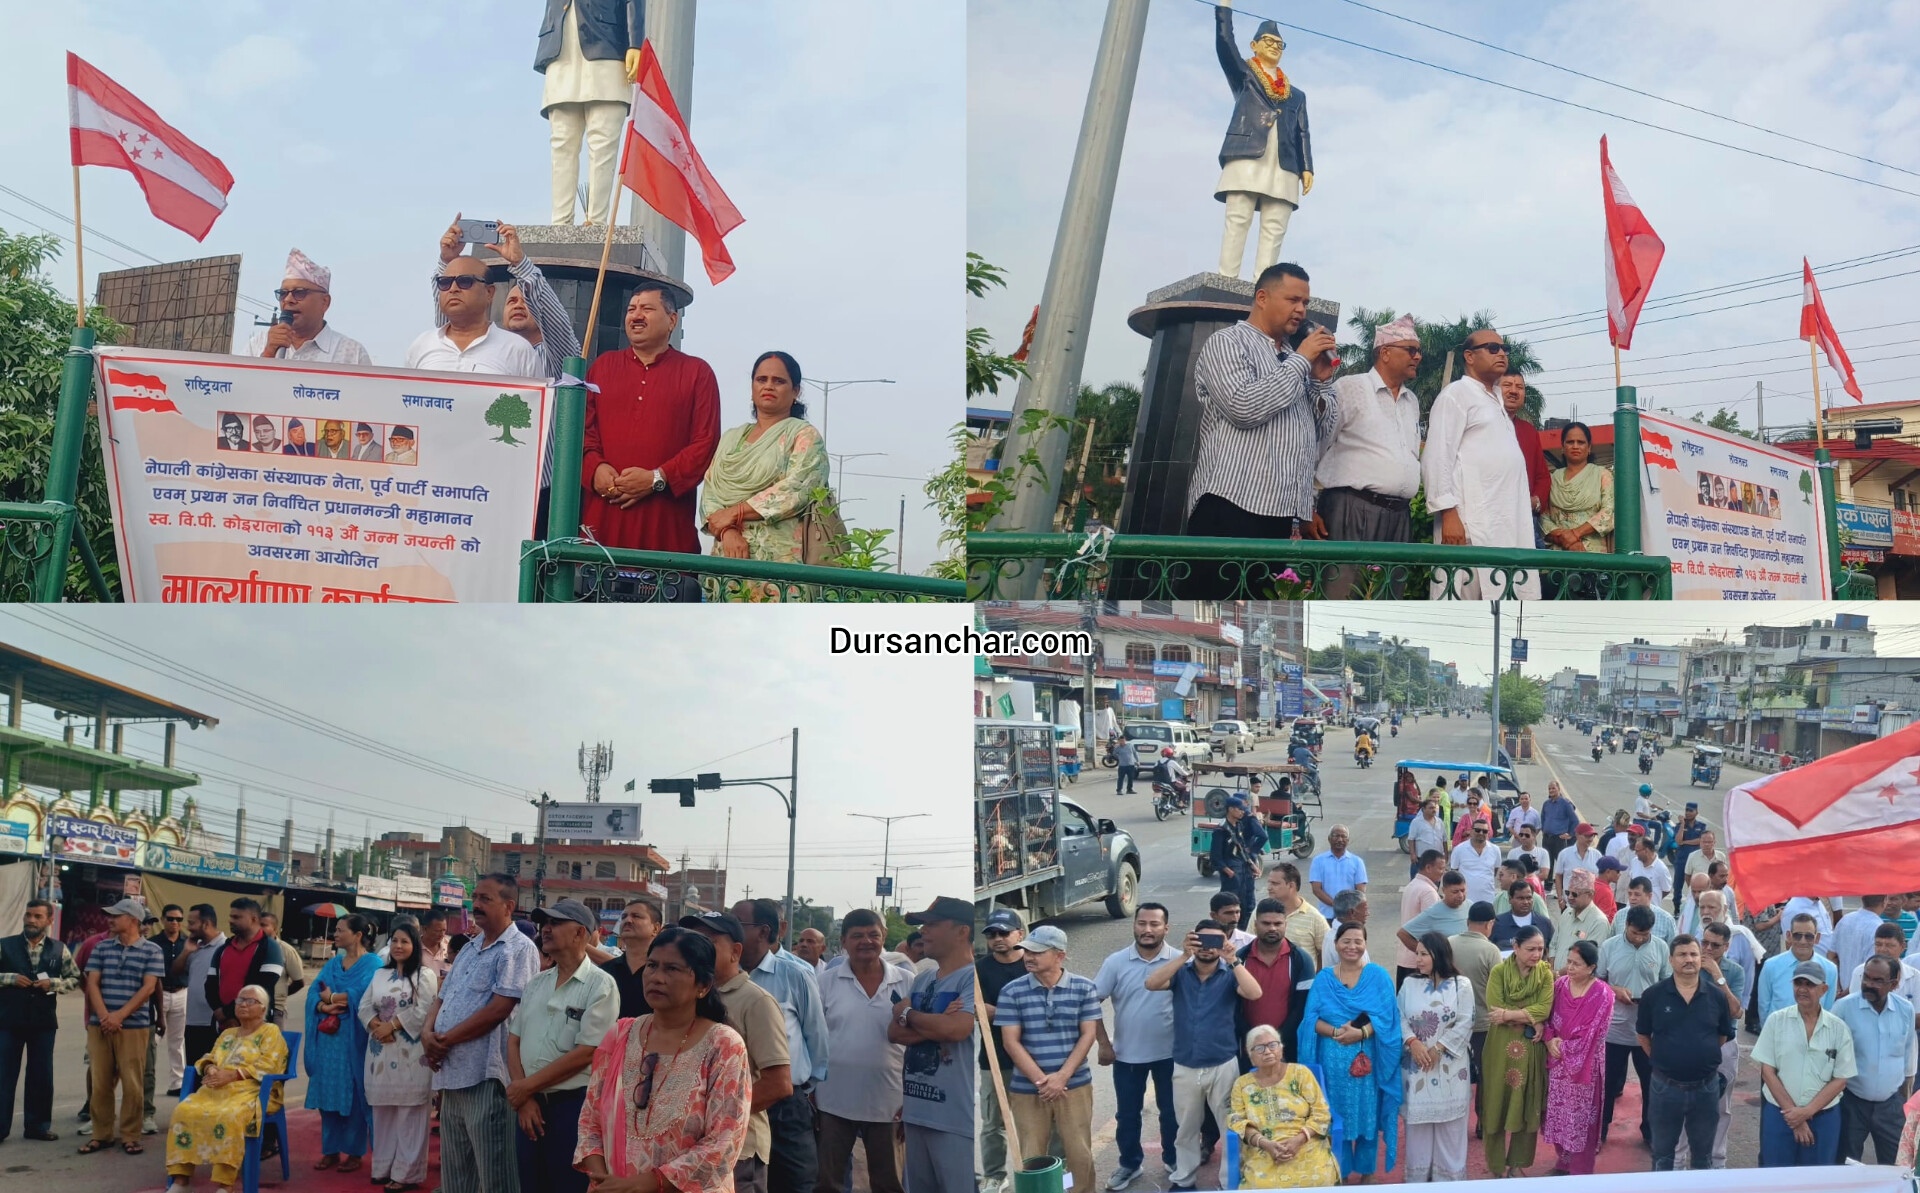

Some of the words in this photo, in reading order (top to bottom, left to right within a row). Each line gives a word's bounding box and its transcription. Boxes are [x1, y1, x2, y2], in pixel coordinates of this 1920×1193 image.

[184, 376, 233, 395] राष्ट्रियता
[293, 384, 341, 401] लोकतन्त्र
[402, 394, 455, 412] समाजवाद
[145, 458, 192, 476] नेपाली
[195, 462, 259, 480] कांग्रेसका
[263, 467, 328, 486] संस्थापक
[332, 472, 364, 492] नेता,
[370, 477, 394, 497] पूर्व
[396, 480, 429, 496] पार्टी
[432, 485, 490, 502] सभापति
[152, 487, 187, 506] एवम्
[190, 489, 228, 504] प्रथम
[233, 492, 258, 506] जन
[263, 491, 320, 512] निर्वाचित
[325, 500, 401, 519] प्रधानमन्त्री
[406, 508, 474, 527] महामानव
[1666, 510, 1690, 527] नेपाली
[149, 513, 172, 526] स्व.
[178, 511, 216, 528] वि.पी.
[222, 514, 302, 535] कोइरालाको
[306, 524, 334, 541] ११३
[363, 530, 399, 545] जन्म
[404, 533, 456, 550] जयन्ती
[460, 536, 481, 553] को
[248, 544, 311, 561] अवसरमा
[315, 550, 379, 569] आयोजित
